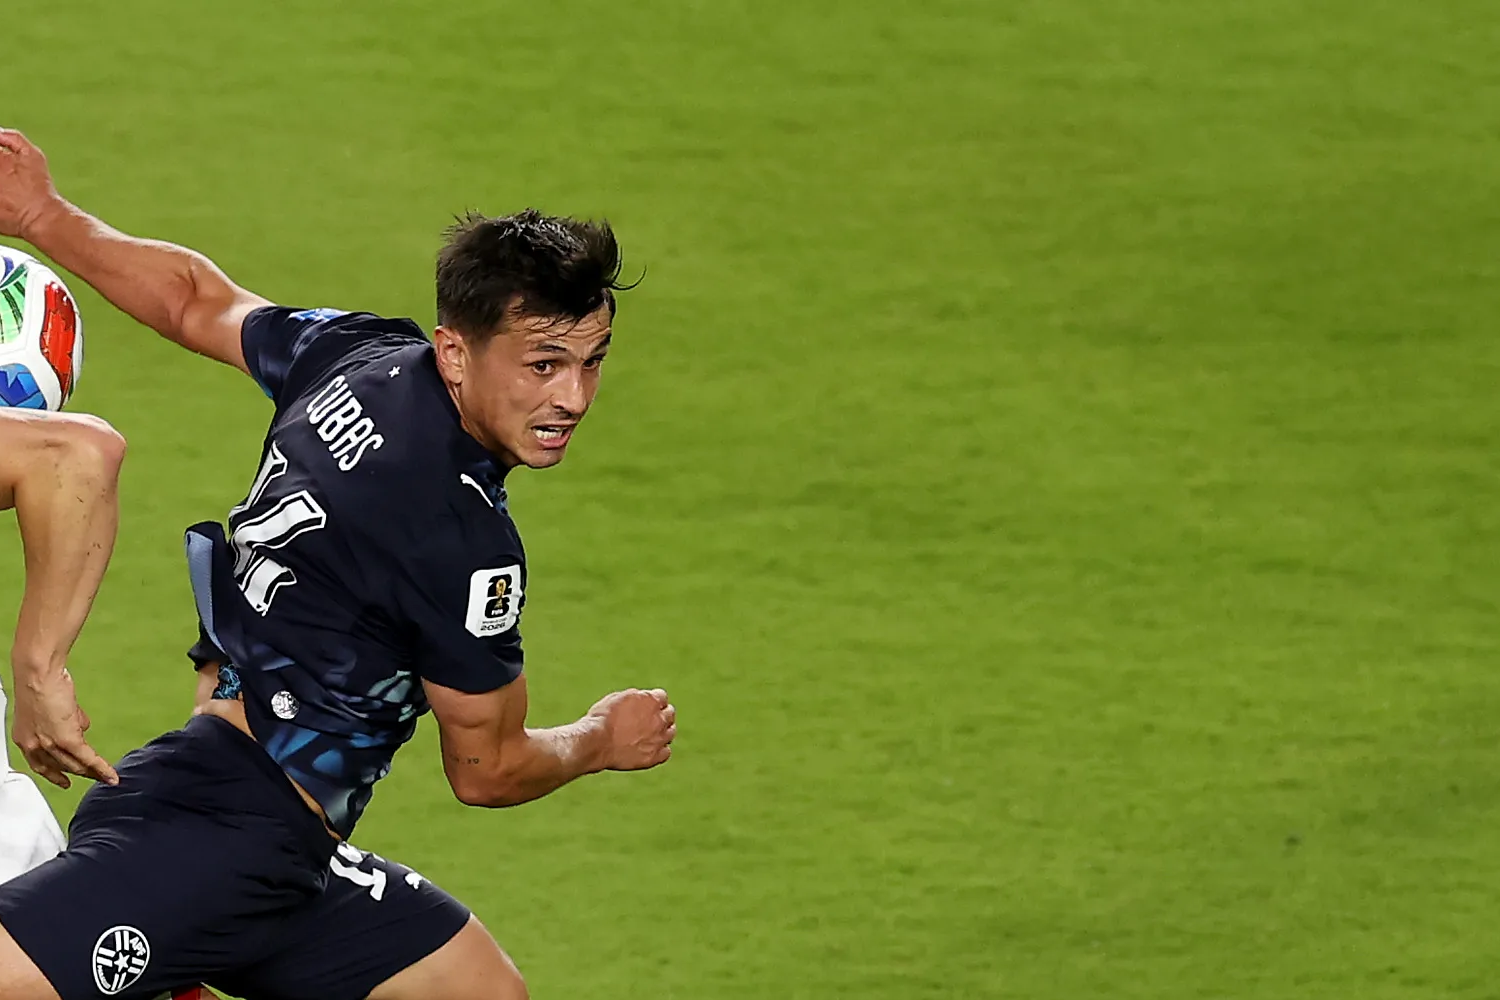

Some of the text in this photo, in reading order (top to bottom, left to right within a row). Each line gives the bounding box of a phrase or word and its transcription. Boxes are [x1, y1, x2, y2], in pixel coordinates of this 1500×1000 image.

[306, 375, 384, 471] CUBAS
[480, 622, 506, 631] 2026
[130, 936, 146, 956] APF
